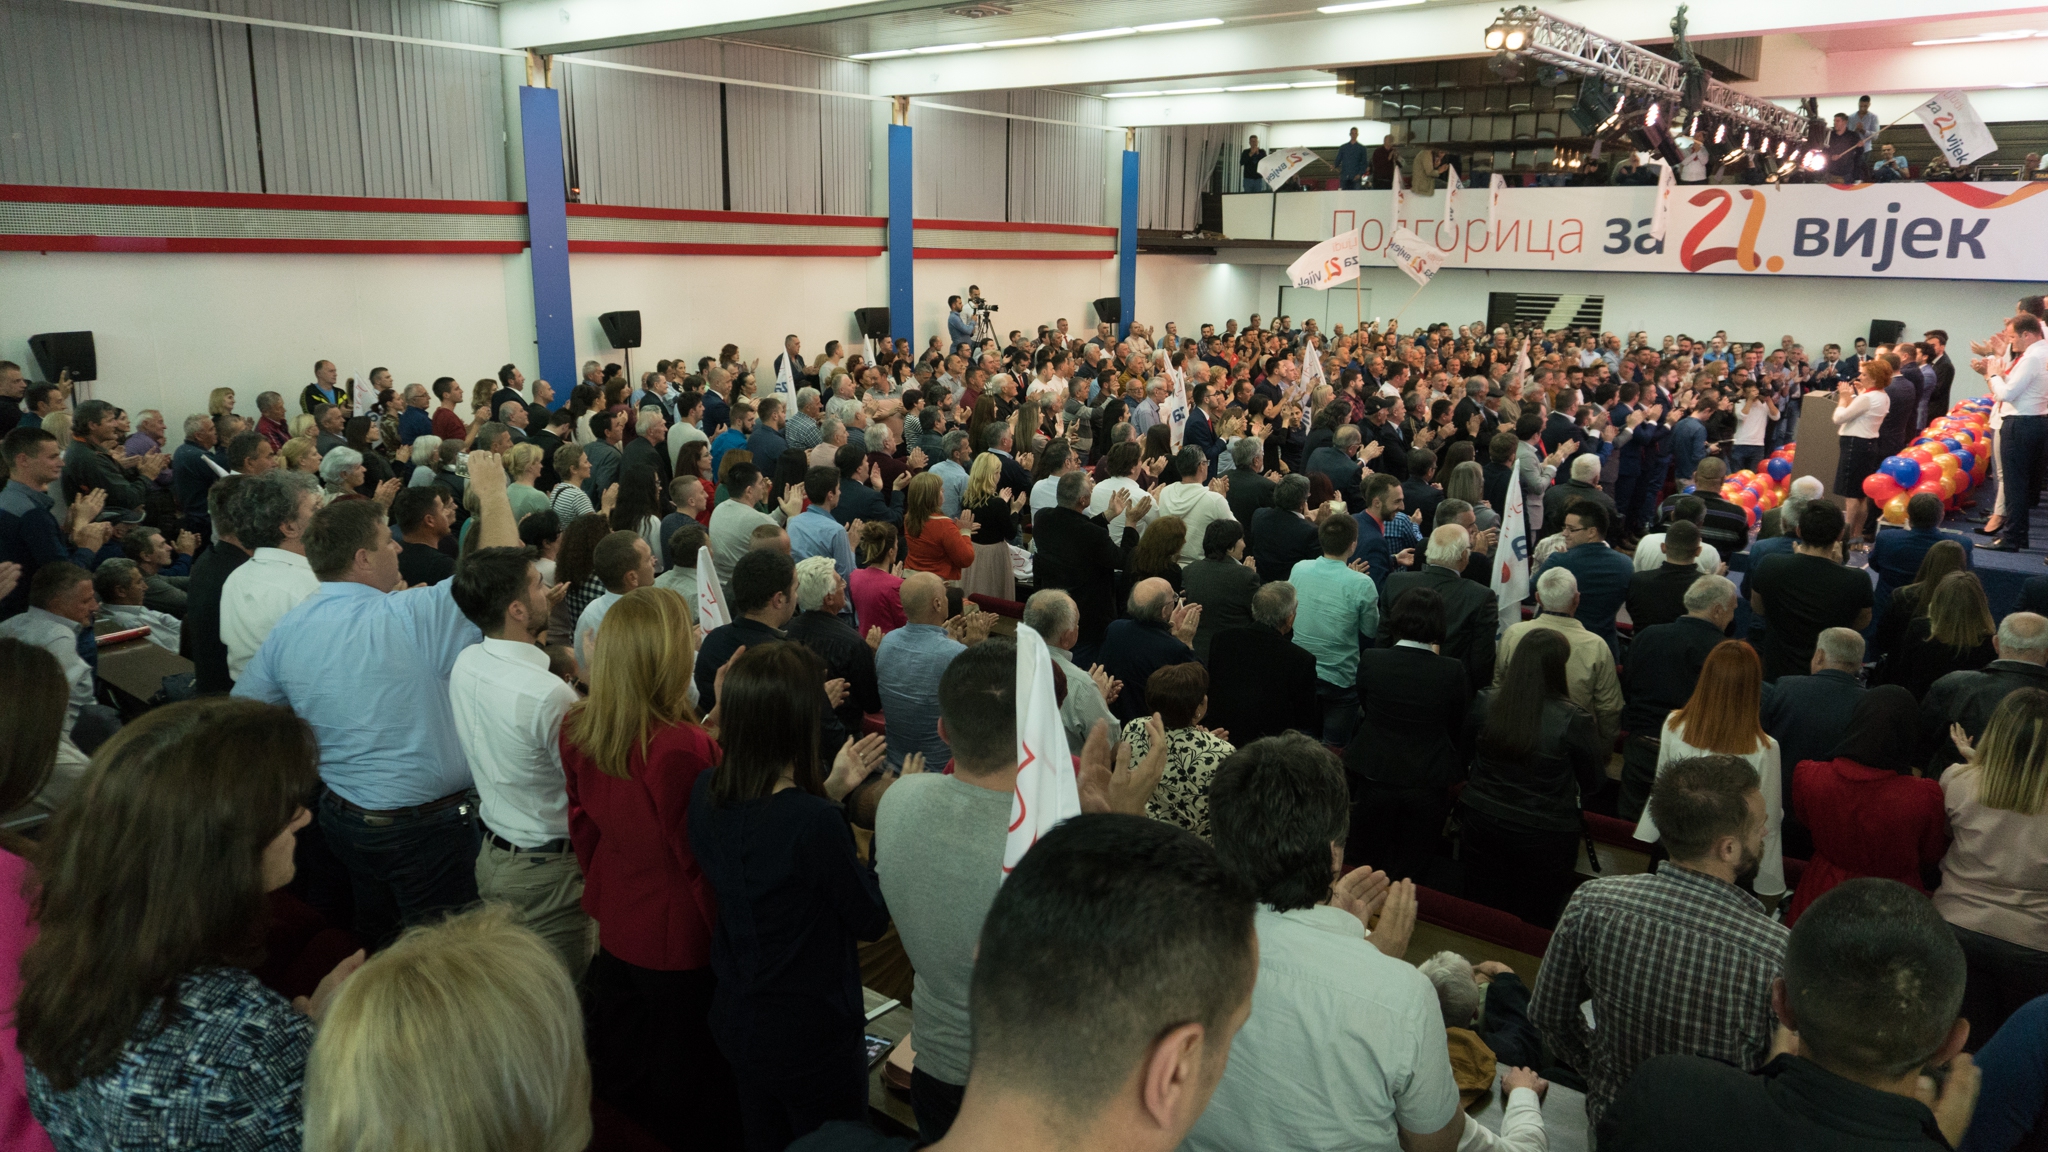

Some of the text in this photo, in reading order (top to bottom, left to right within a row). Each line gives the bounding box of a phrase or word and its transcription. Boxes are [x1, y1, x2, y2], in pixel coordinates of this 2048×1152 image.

[1926, 100, 1942, 114] za
[1946, 133, 1970, 164] vijek
[1793, 201, 1991, 272] вијек
